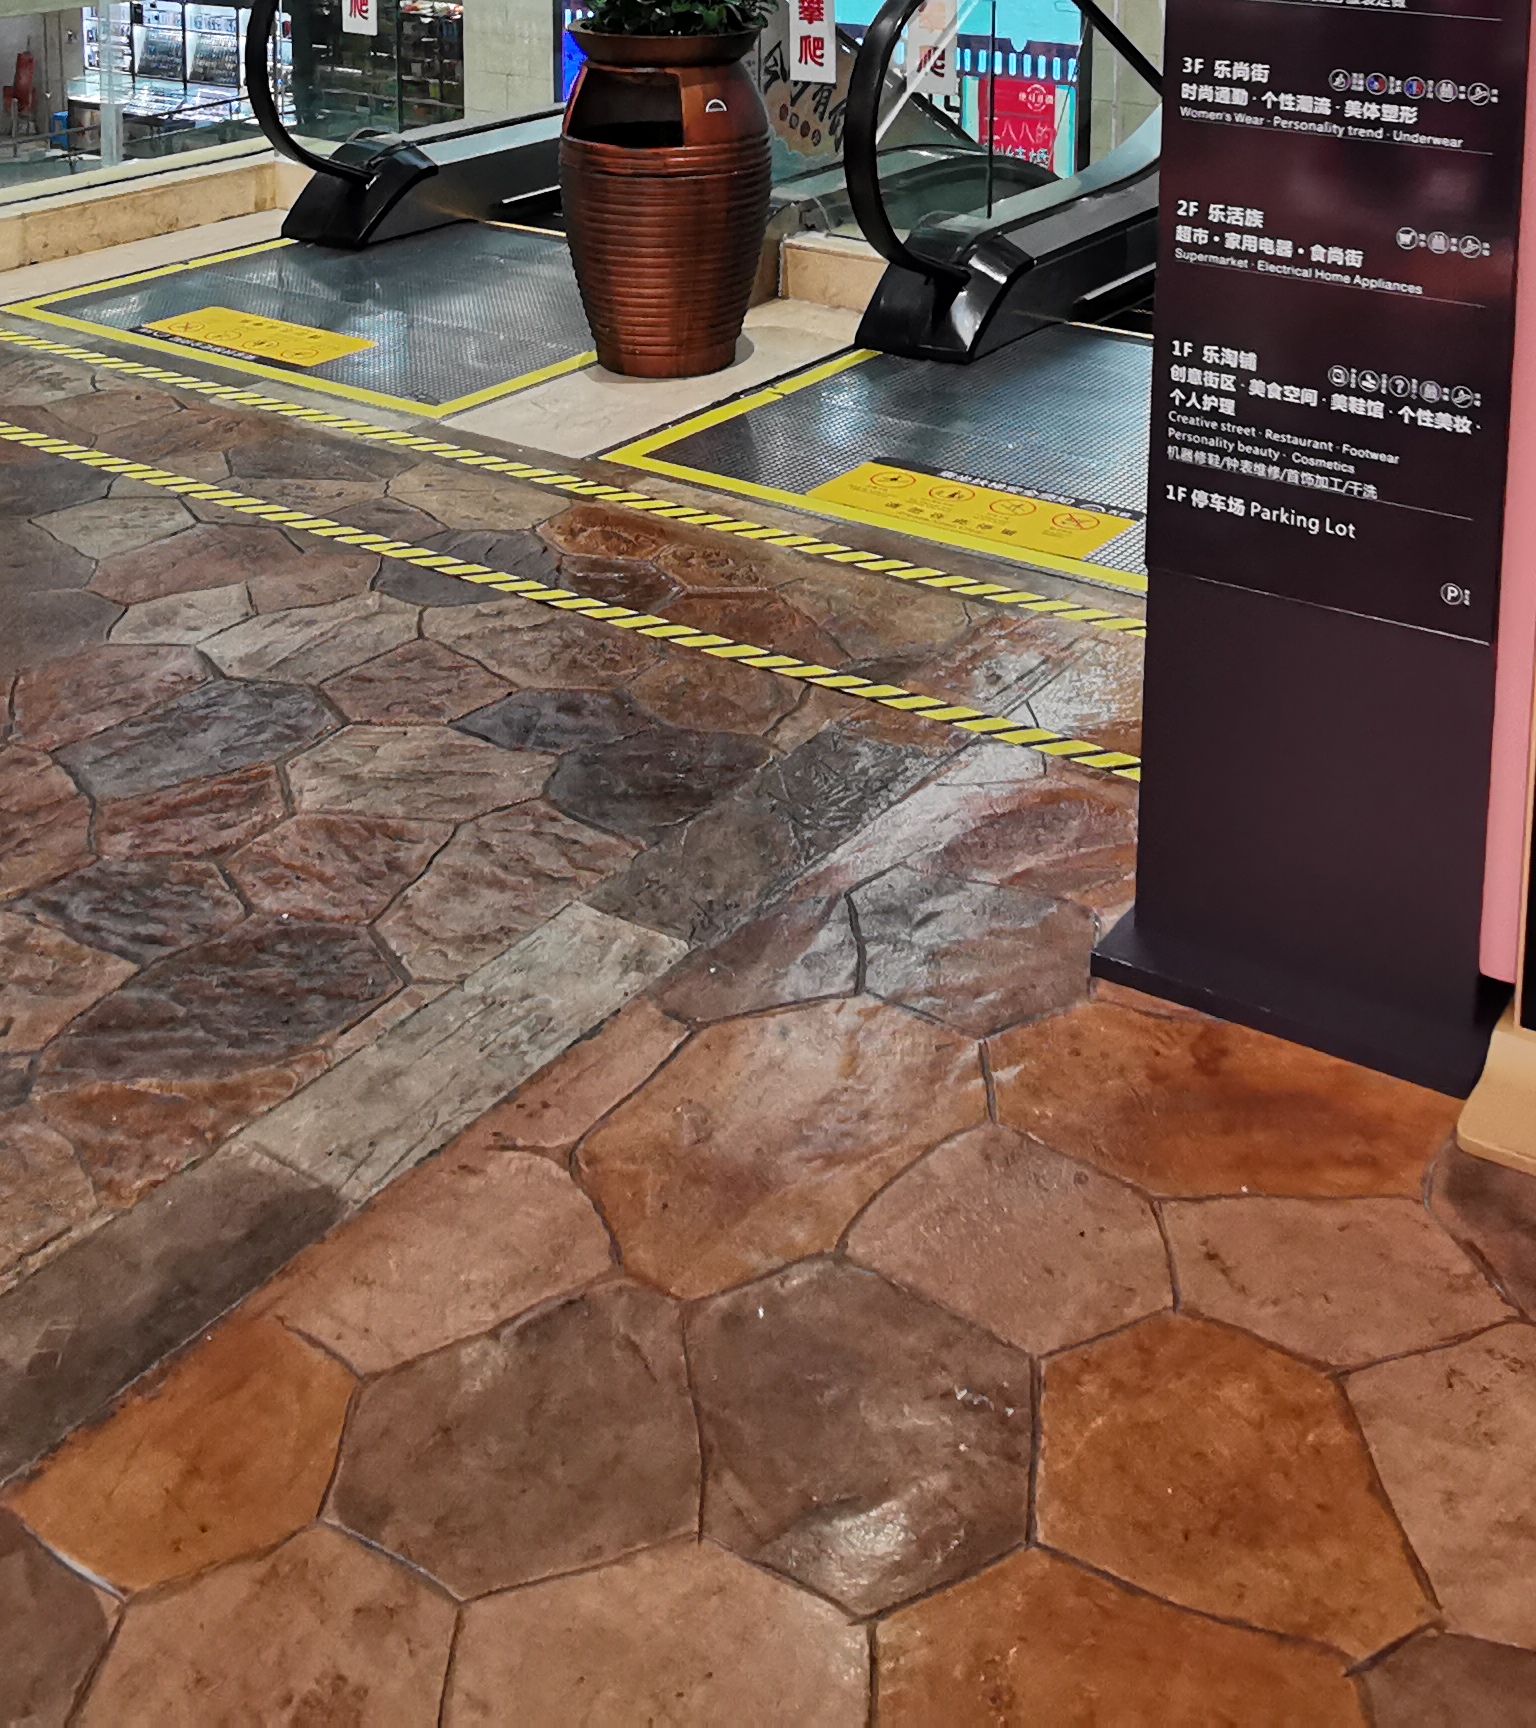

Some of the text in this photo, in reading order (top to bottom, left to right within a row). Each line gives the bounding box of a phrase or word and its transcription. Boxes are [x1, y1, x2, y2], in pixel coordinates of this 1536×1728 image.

[1182, 56, 1271, 84] 3F 乐尚街
[1179, 105, 1465, 149] Women's Wear Personality trend Underwear
[1261, 90, 1332, 116] 个性潮流
[1343, 99, 1419, 125] 美体塑形
[1176, 199, 1265, 230] 2F 乐活族
[1175, 224, 1364, 269] 超市 家用电器 食尚街
[1174, 247, 1423, 296] Supermarket Electrical Home Appliances
[1172, 339, 1258, 372] 1F 乐淘铺
[1169, 363, 1238, 393] 创意街区
[1249, 377, 1319, 408] 美食空间
[1329, 393, 1386, 420] 美鞋馆
[1169, 387, 1237, 417] 个人护理
[1167, 409, 1400, 465] Creative street Restaurant Footwear
[1167, 426, 1356, 474] Personality beauty Cosmetics
[1165, 484, 1357, 540] 1F 停车场 Parking Lot
